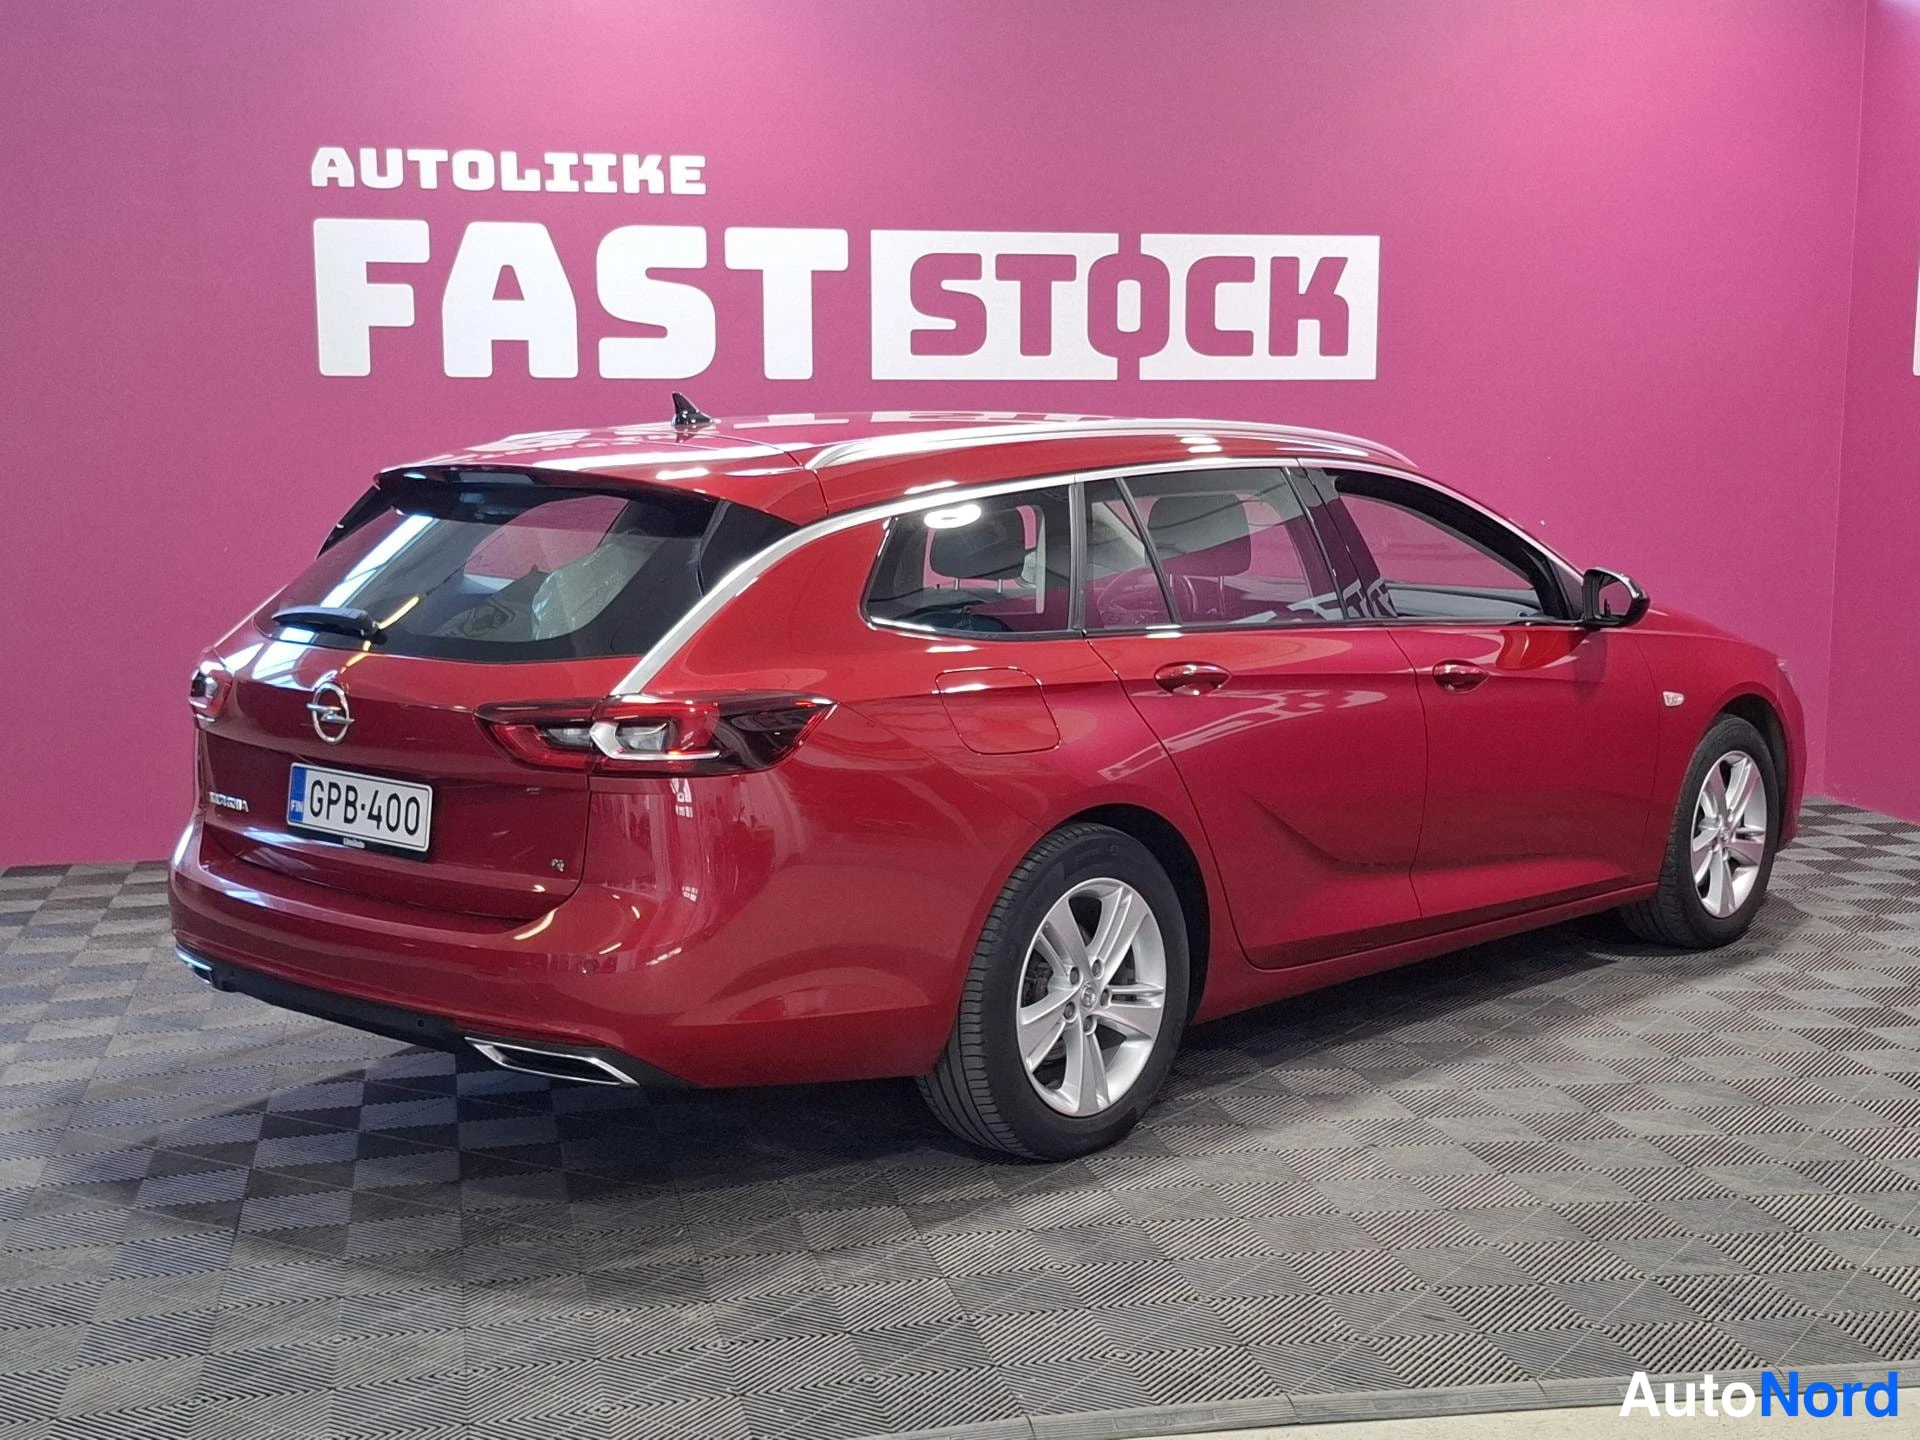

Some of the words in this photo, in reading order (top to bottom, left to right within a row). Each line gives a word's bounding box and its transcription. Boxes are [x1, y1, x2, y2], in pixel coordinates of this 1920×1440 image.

[310, 146, 707, 195] AUTOLIIKE
[313, 217, 849, 380] FAST
[907, 250, 1351, 359] STOCK
[309, 779, 421, 836] GPB-400
